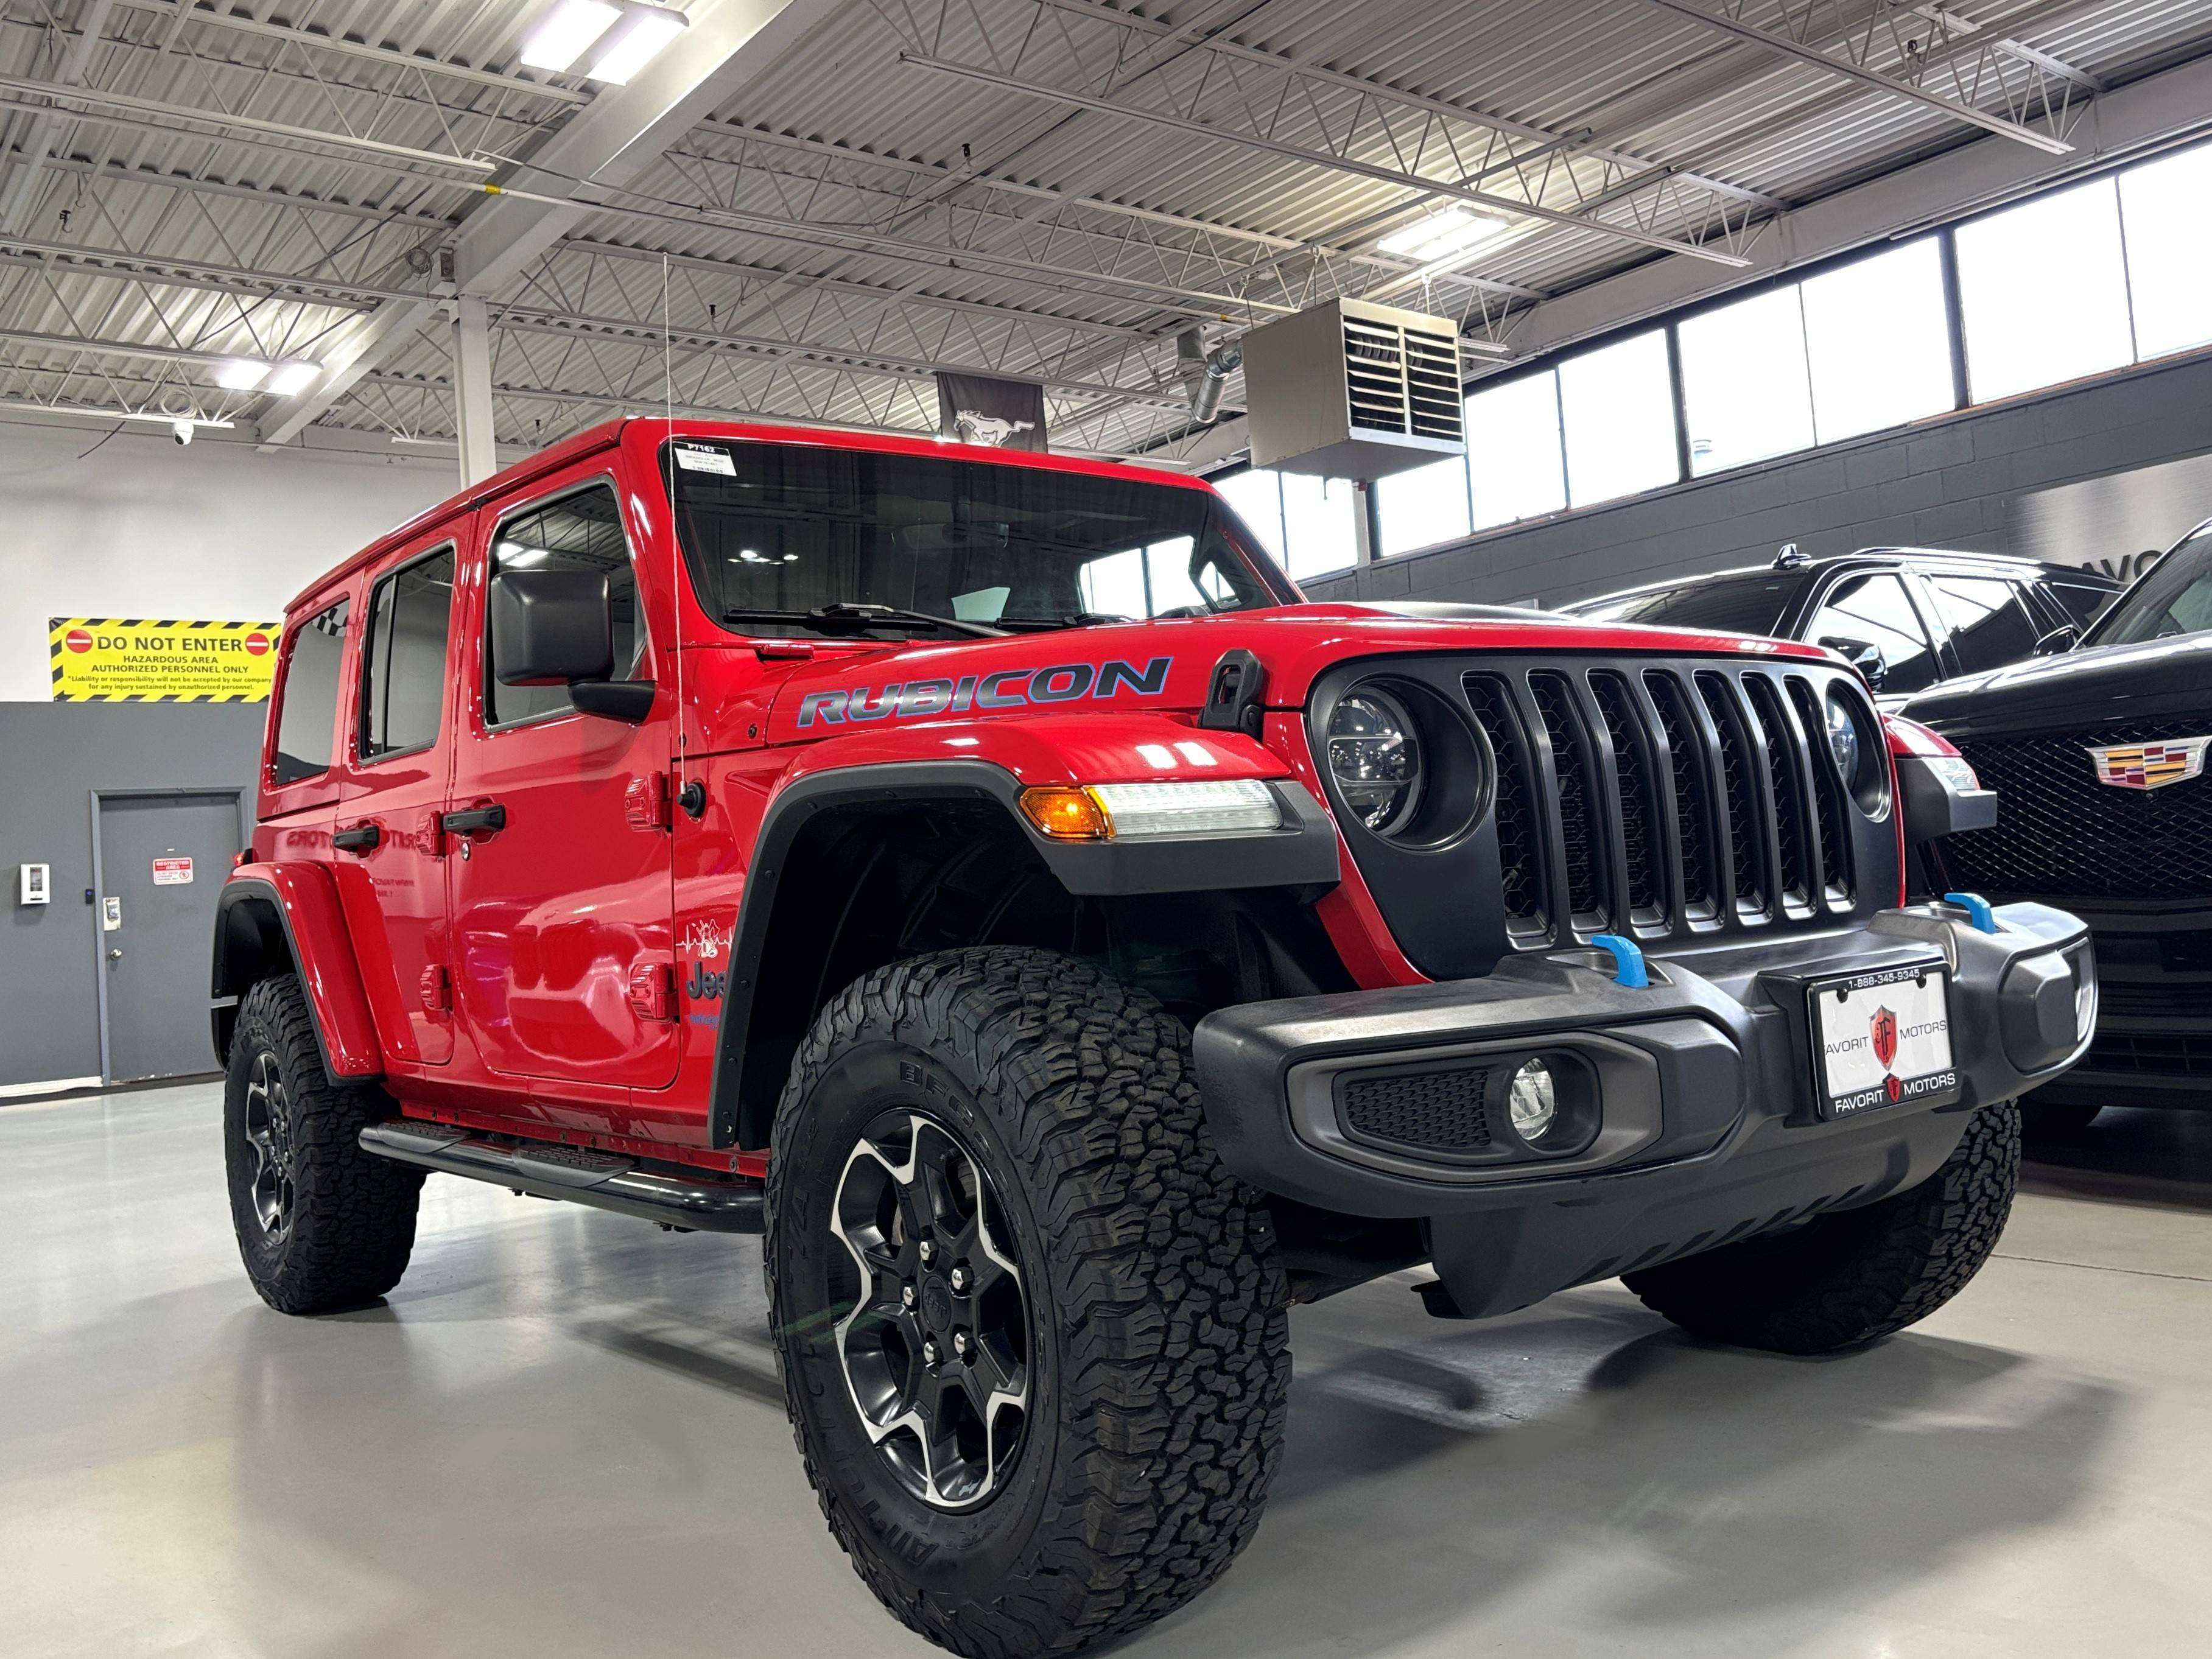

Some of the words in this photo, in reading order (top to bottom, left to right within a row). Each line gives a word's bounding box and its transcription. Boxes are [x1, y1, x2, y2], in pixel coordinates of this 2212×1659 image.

[97, 636, 127, 650] DO
[135, 637, 175, 651] NOT
[182, 637, 242, 652] ENTER
[91, 664, 158, 673] AUTHORIZED
[161, 665, 220, 673] PERSONNEL
[123, 655, 188, 664] HAZARDOUS
[797, 656, 1174, 728] RUBICON
[686, 961, 728, 1000] Jee
[1849, 969, 1920, 989] 1-888-345-9345
[1824, 1036, 1869, 1056] AVORIT
[1900, 1020, 1947, 1040] MOTORS
[1835, 1089, 1884, 1114] FAVORIT
[1903, 1073, 1956, 1096] MOTORS
